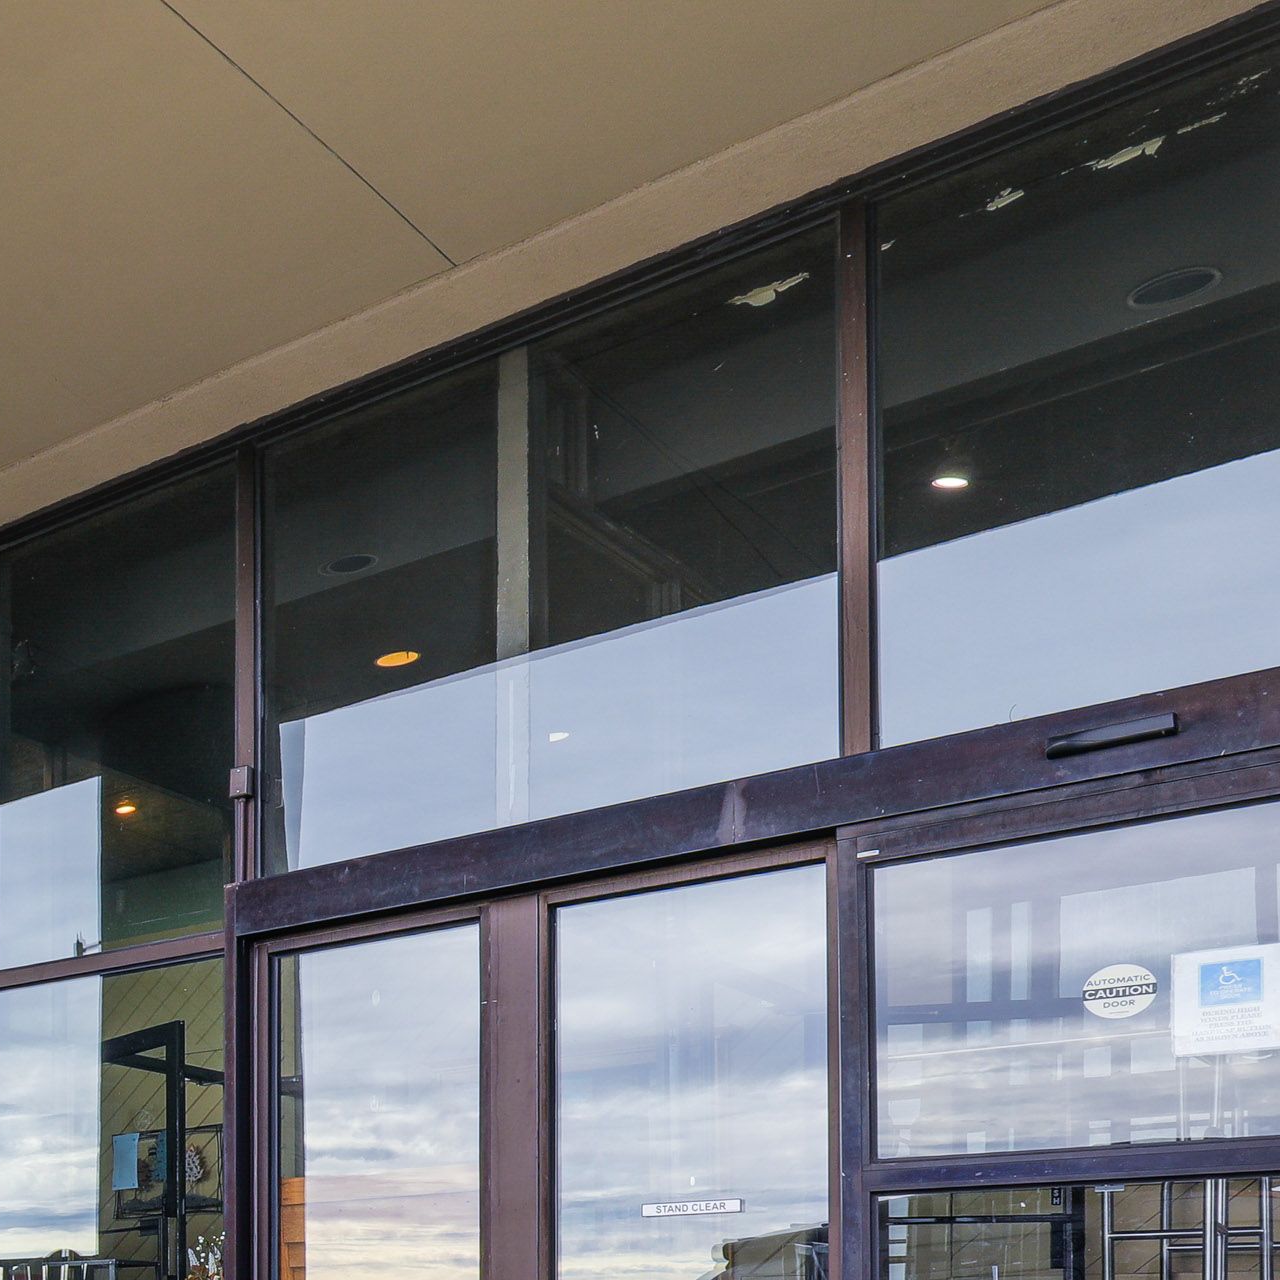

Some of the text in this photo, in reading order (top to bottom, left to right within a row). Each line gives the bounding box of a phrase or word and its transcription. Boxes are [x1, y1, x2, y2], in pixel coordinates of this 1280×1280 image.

[1086, 974, 1151, 987] AUTOMATIC
[1085, 984, 1153, 1000] CAUTION
[1103, 999, 1136, 1009] DOOR
[655, 1201, 727, 1214] STAND CLEAR
